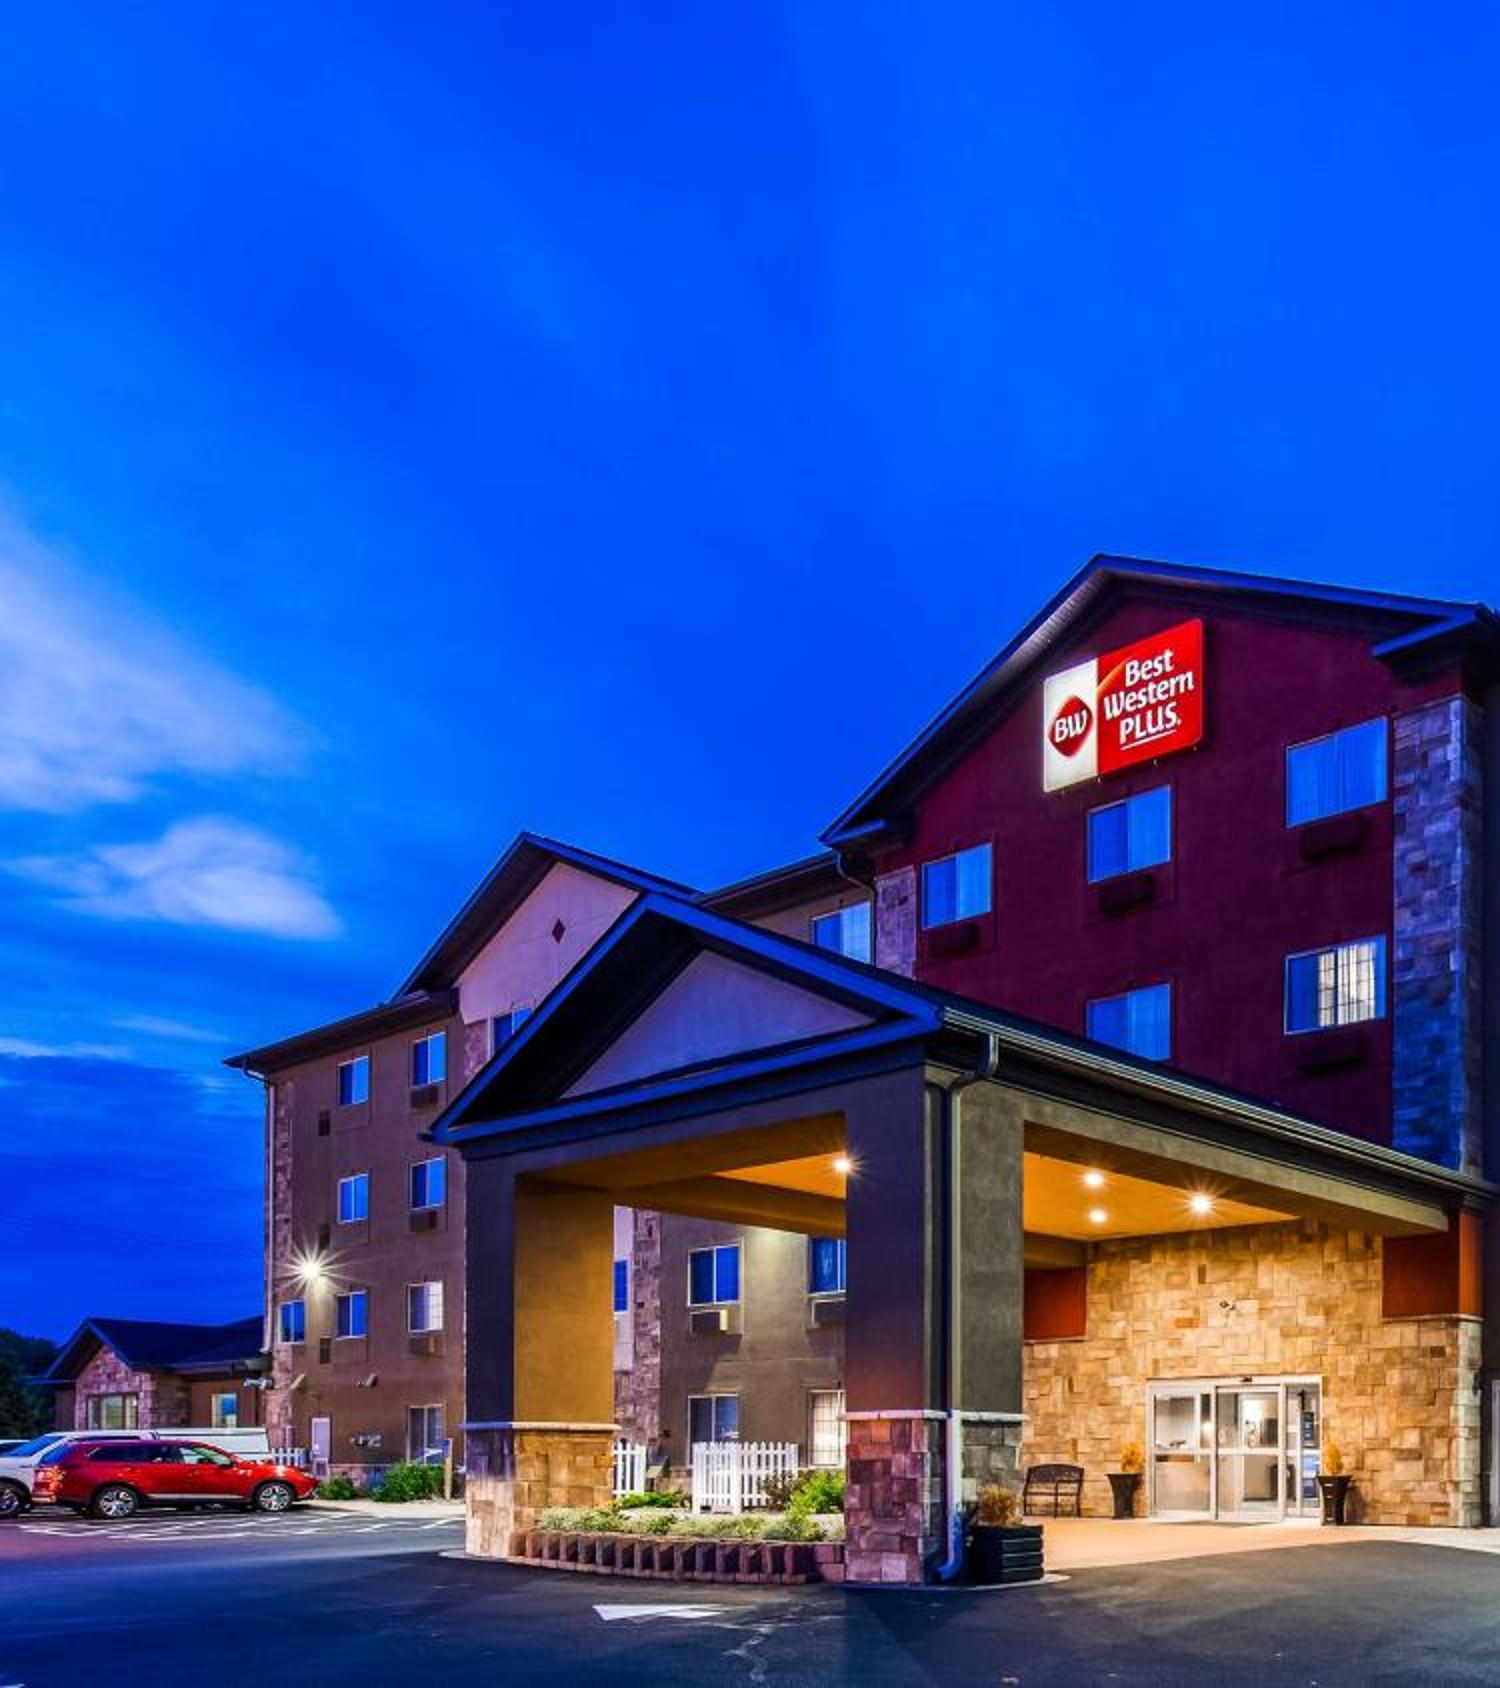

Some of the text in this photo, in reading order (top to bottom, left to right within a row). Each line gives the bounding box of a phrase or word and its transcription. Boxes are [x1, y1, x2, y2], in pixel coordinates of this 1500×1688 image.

[1125, 649, 1174, 687] Best
[1103, 671, 1194, 720] Western
[1055, 710, 1088, 743] BW
